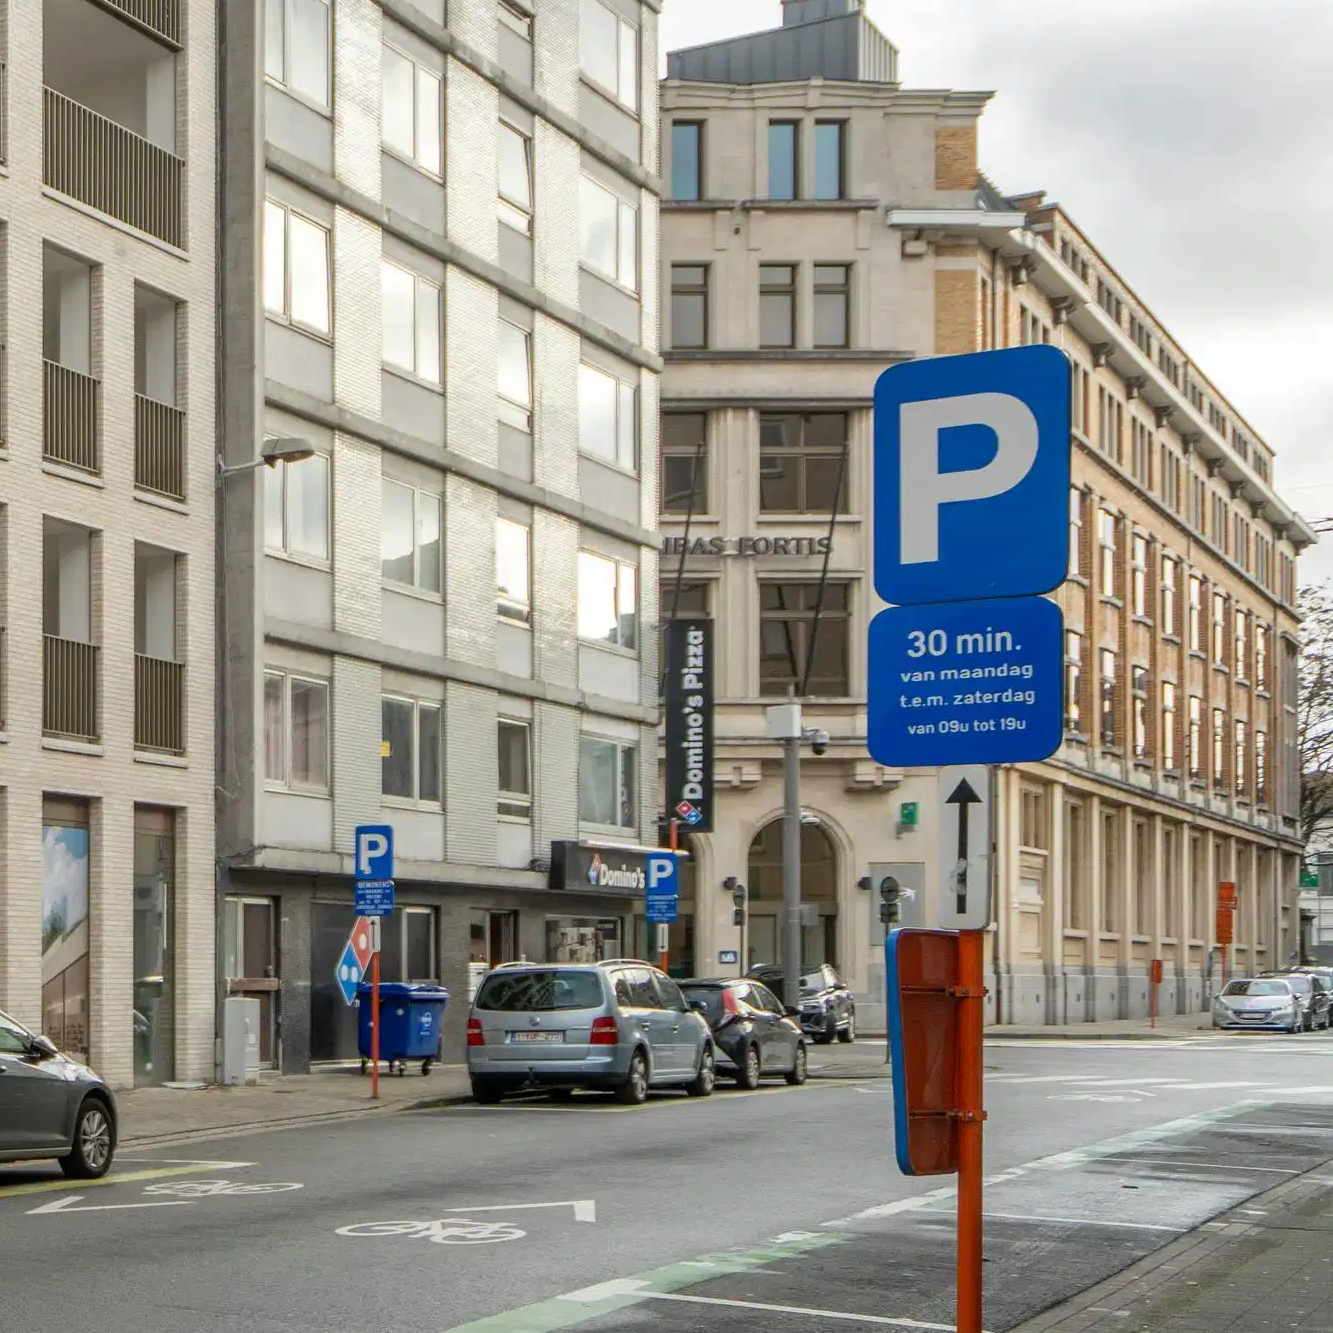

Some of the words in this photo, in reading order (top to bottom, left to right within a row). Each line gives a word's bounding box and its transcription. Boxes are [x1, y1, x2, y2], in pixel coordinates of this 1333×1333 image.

[900, 392, 1039, 565] P
[739, 536, 833, 555] FORTIS
[907, 629, 948, 658] 30
[956, 626, 1022, 654] min.
[682, 630, 704, 690] Pizza
[900, 670, 935, 682] van
[940, 663, 1033, 679] maandag
[900, 694, 948, 708] t.e.m.
[953, 688, 1035, 705] zaterdag
[907, 724, 935, 735] van
[938, 720, 969, 734] 09u
[973, 719, 996, 732] tot
[1000, 717, 1026, 730] 19u
[682, 694, 704, 800] Domino's
[360, 834, 388, 874] P
[599, 863, 646, 889] Domino's
[649, 859, 673, 888] P
